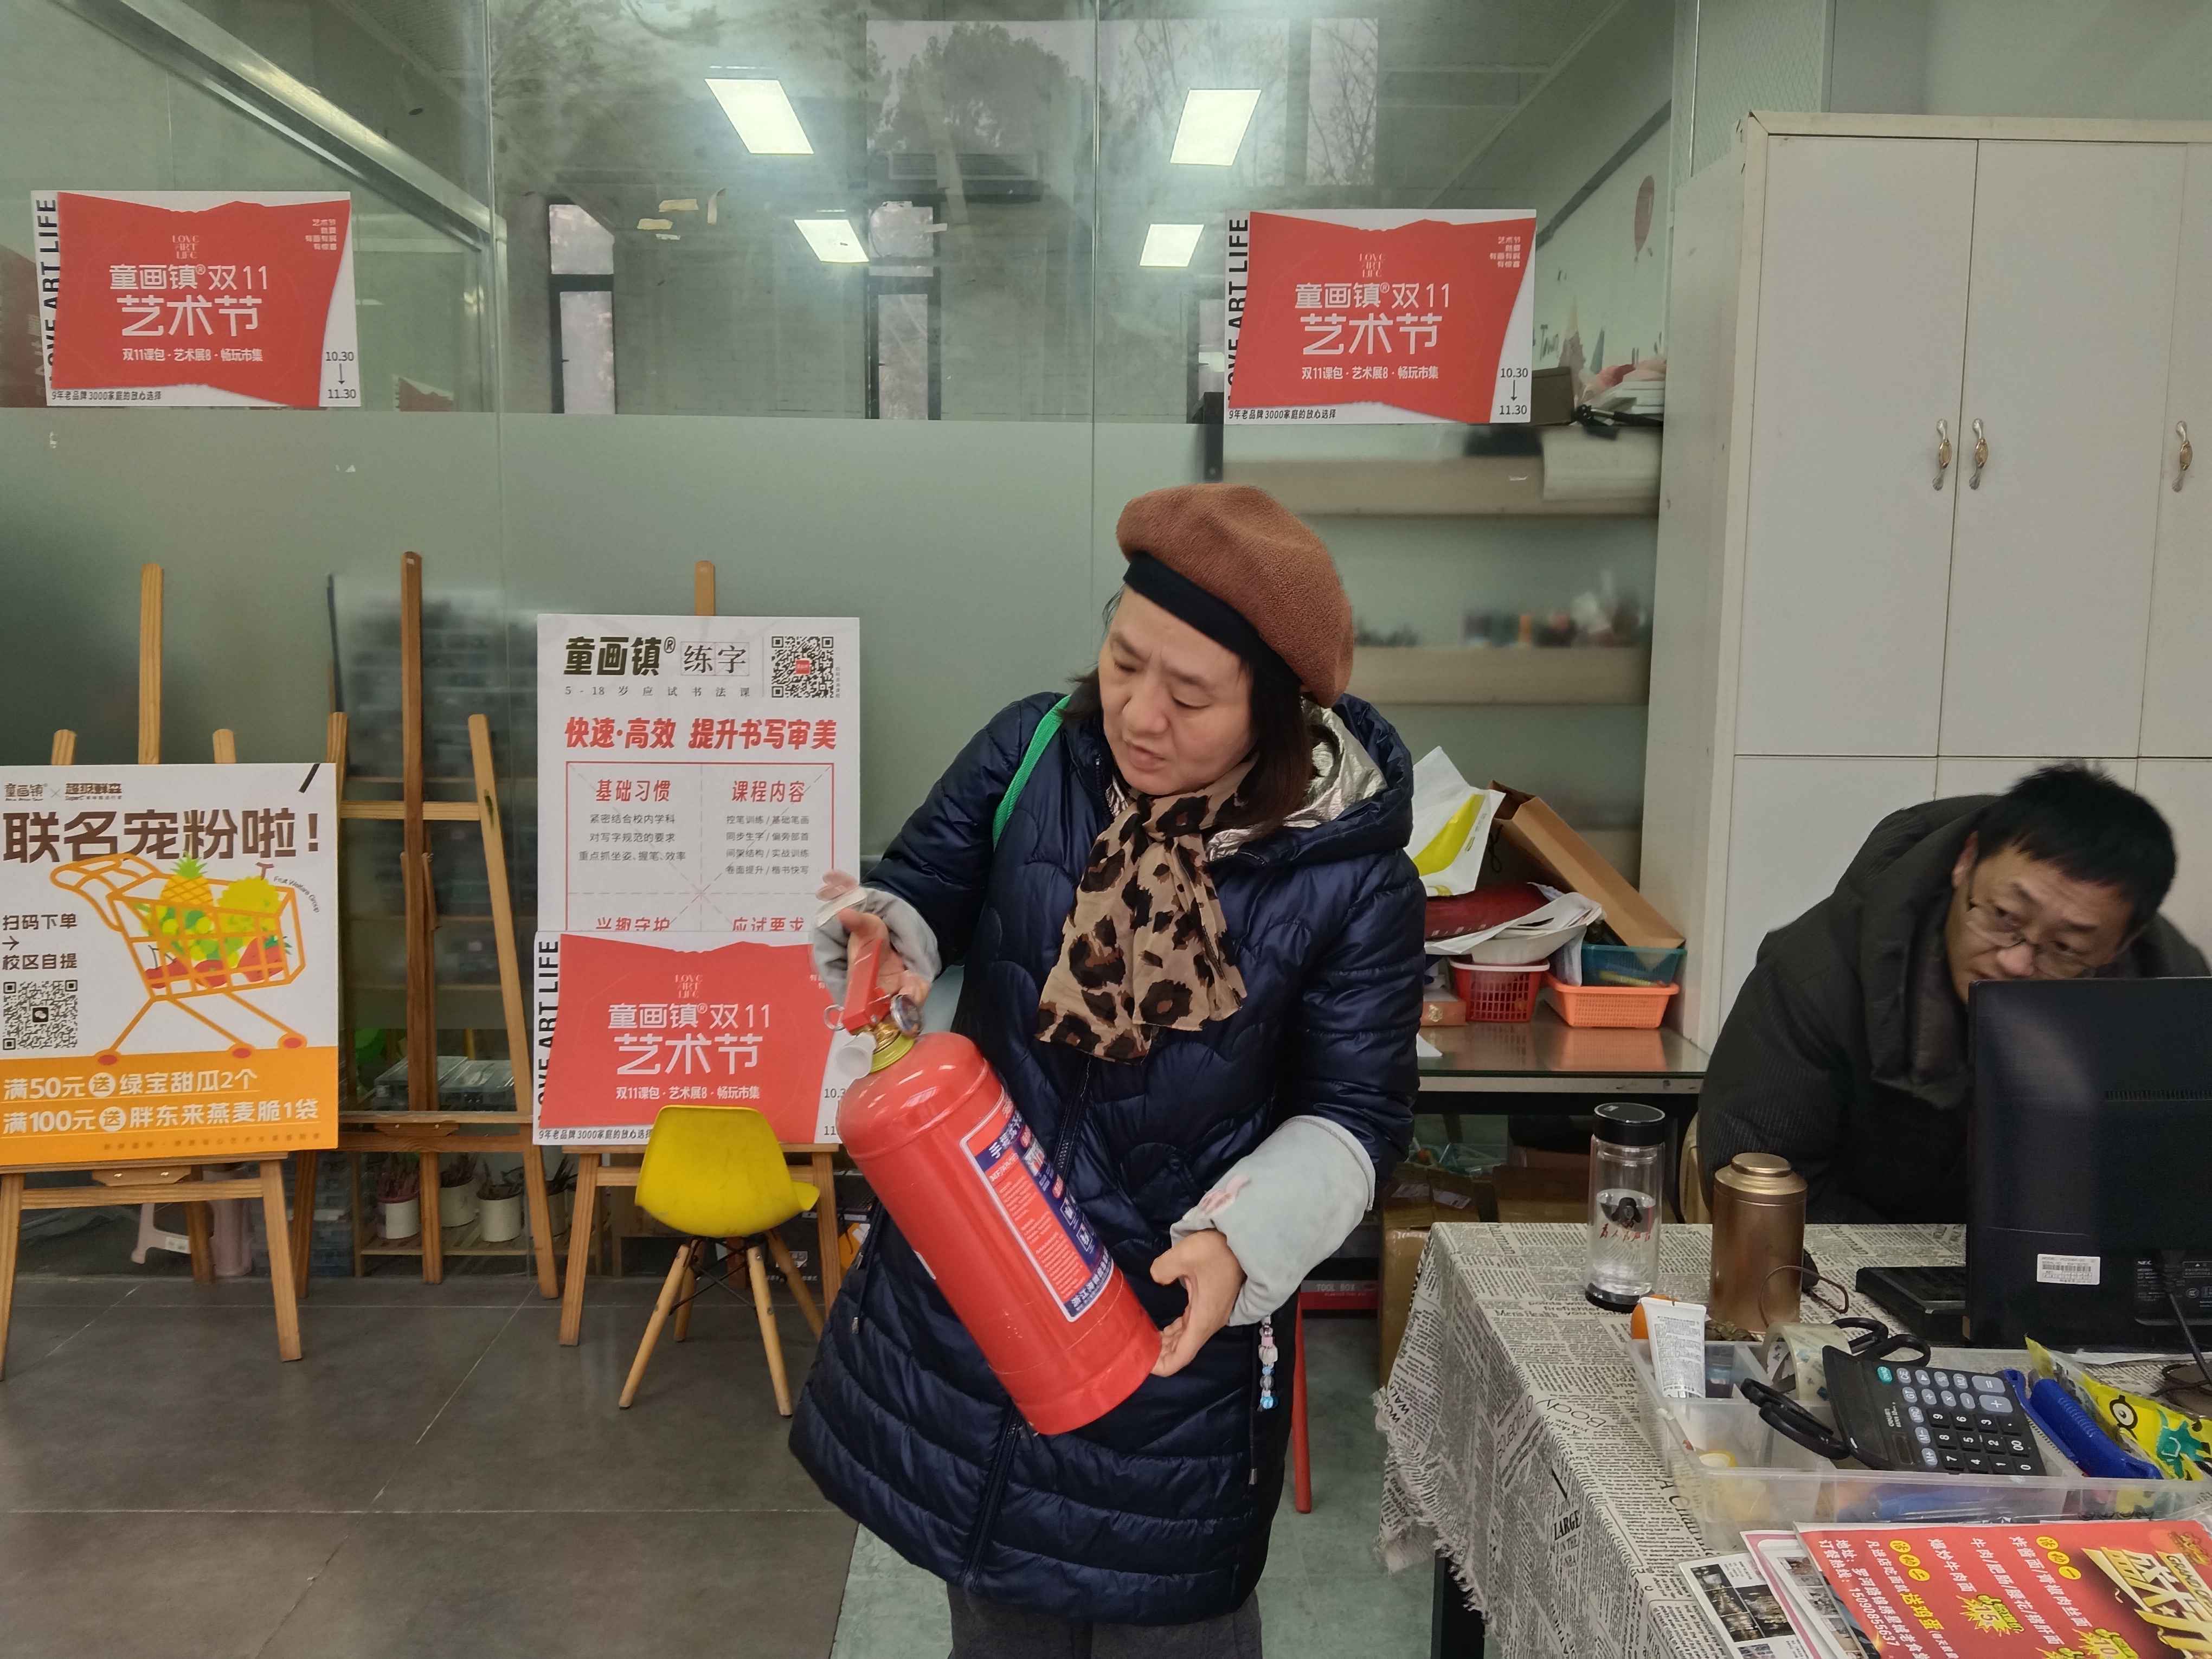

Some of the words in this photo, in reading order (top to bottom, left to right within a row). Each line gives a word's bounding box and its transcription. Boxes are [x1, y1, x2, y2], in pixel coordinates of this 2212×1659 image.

[36, 200, 59, 253] LIFE
[172, 235, 199, 243] LOVE
[1229, 220, 1248, 272] LIFE
[176, 251, 197, 259] LIFE
[117, 294, 262, 337] 艺术节
[1300, 313, 1442, 355] 艺术节
[325, 351, 355, 362] 10.30
[1500, 368, 1528, 378] 10.30
[327, 389, 356, 399] 11.30
[1499, 405, 1527, 415] 11.30
[684, 645, 746, 673] 练字
[688, 718, 837, 750] 提升书写审美
[596, 780, 671, 802] 基础习惯
[731, 780, 805, 803] 课程内容
[589, 814, 675, 825] 紧密结合校内学科
[589, 832, 676, 843] 对写字规范的要求
[2, 914, 77, 930] 扫码下单
[2, 954, 77, 970] 校区自提
[538, 941, 558, 993] LIFE
[614, 1032, 763, 1075] 艺术节
[2011, 1440, 2023, 1451] 00
